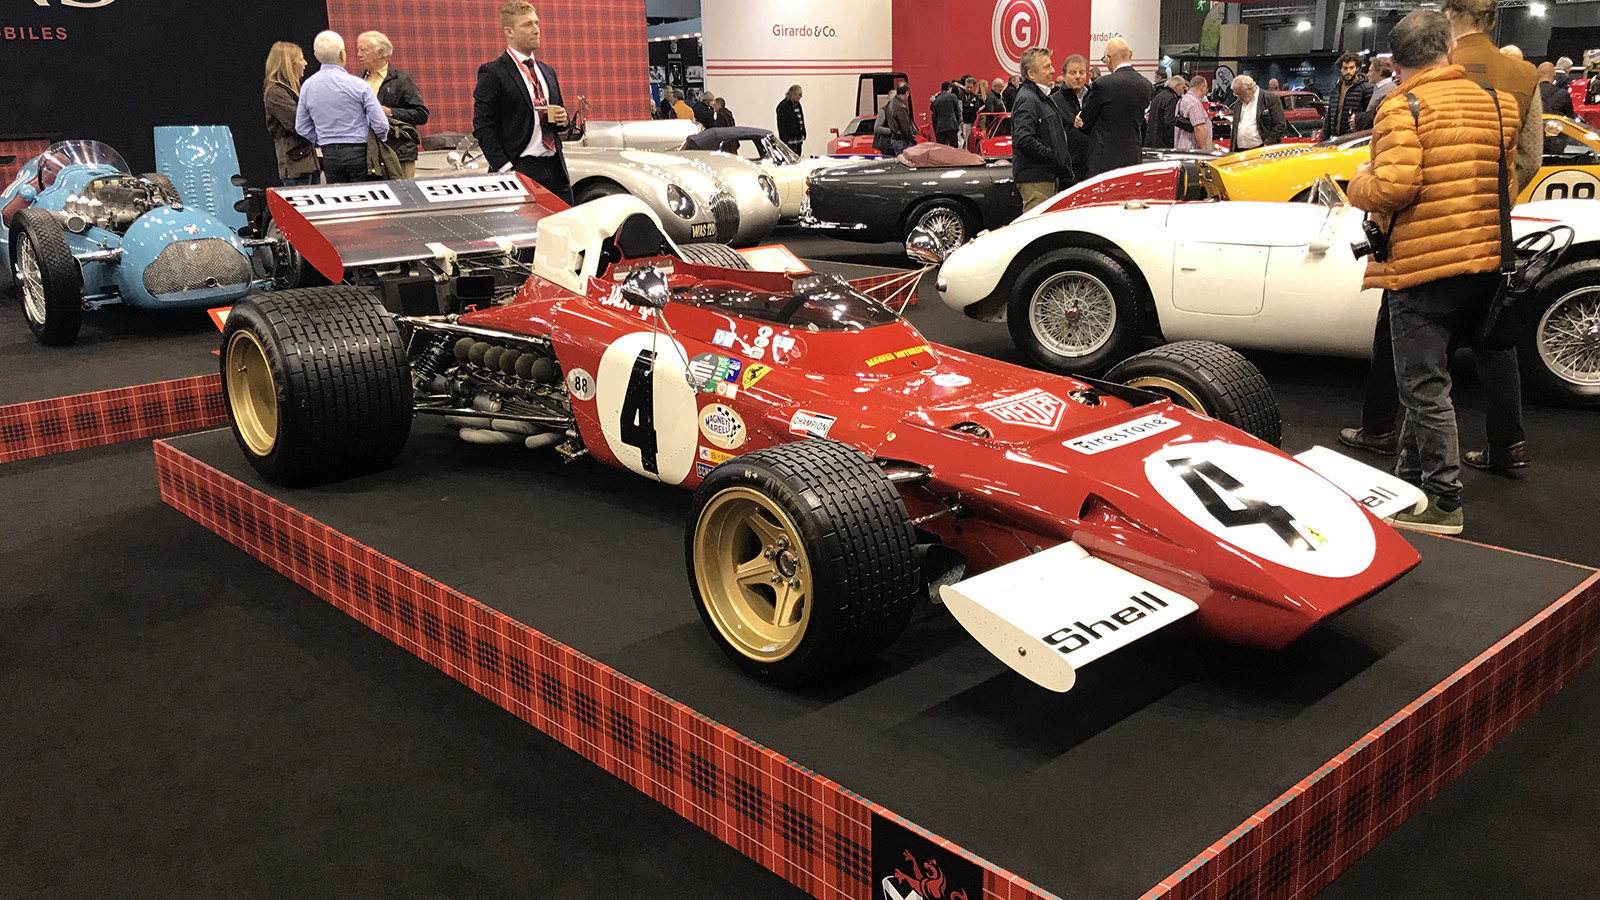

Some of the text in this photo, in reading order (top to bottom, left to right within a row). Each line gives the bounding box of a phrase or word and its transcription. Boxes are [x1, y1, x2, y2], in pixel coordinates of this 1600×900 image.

[0, 26, 68, 40] BILES
[1010, 11, 1031, 48] G
[285, 190, 390, 207] Shell
[427, 181, 519, 196] Shell
[575, 376, 588, 394] 88
[620, 349, 658, 475] 4
[992, 396, 1060, 425] HEUER
[793, 416, 829, 432] CHAMPION
[1073, 419, 1168, 451] Firestone
[1166, 457, 1317, 552] 4
[1357, 486, 1399, 508] ell
[1041, 590, 1169, 654] Shell
